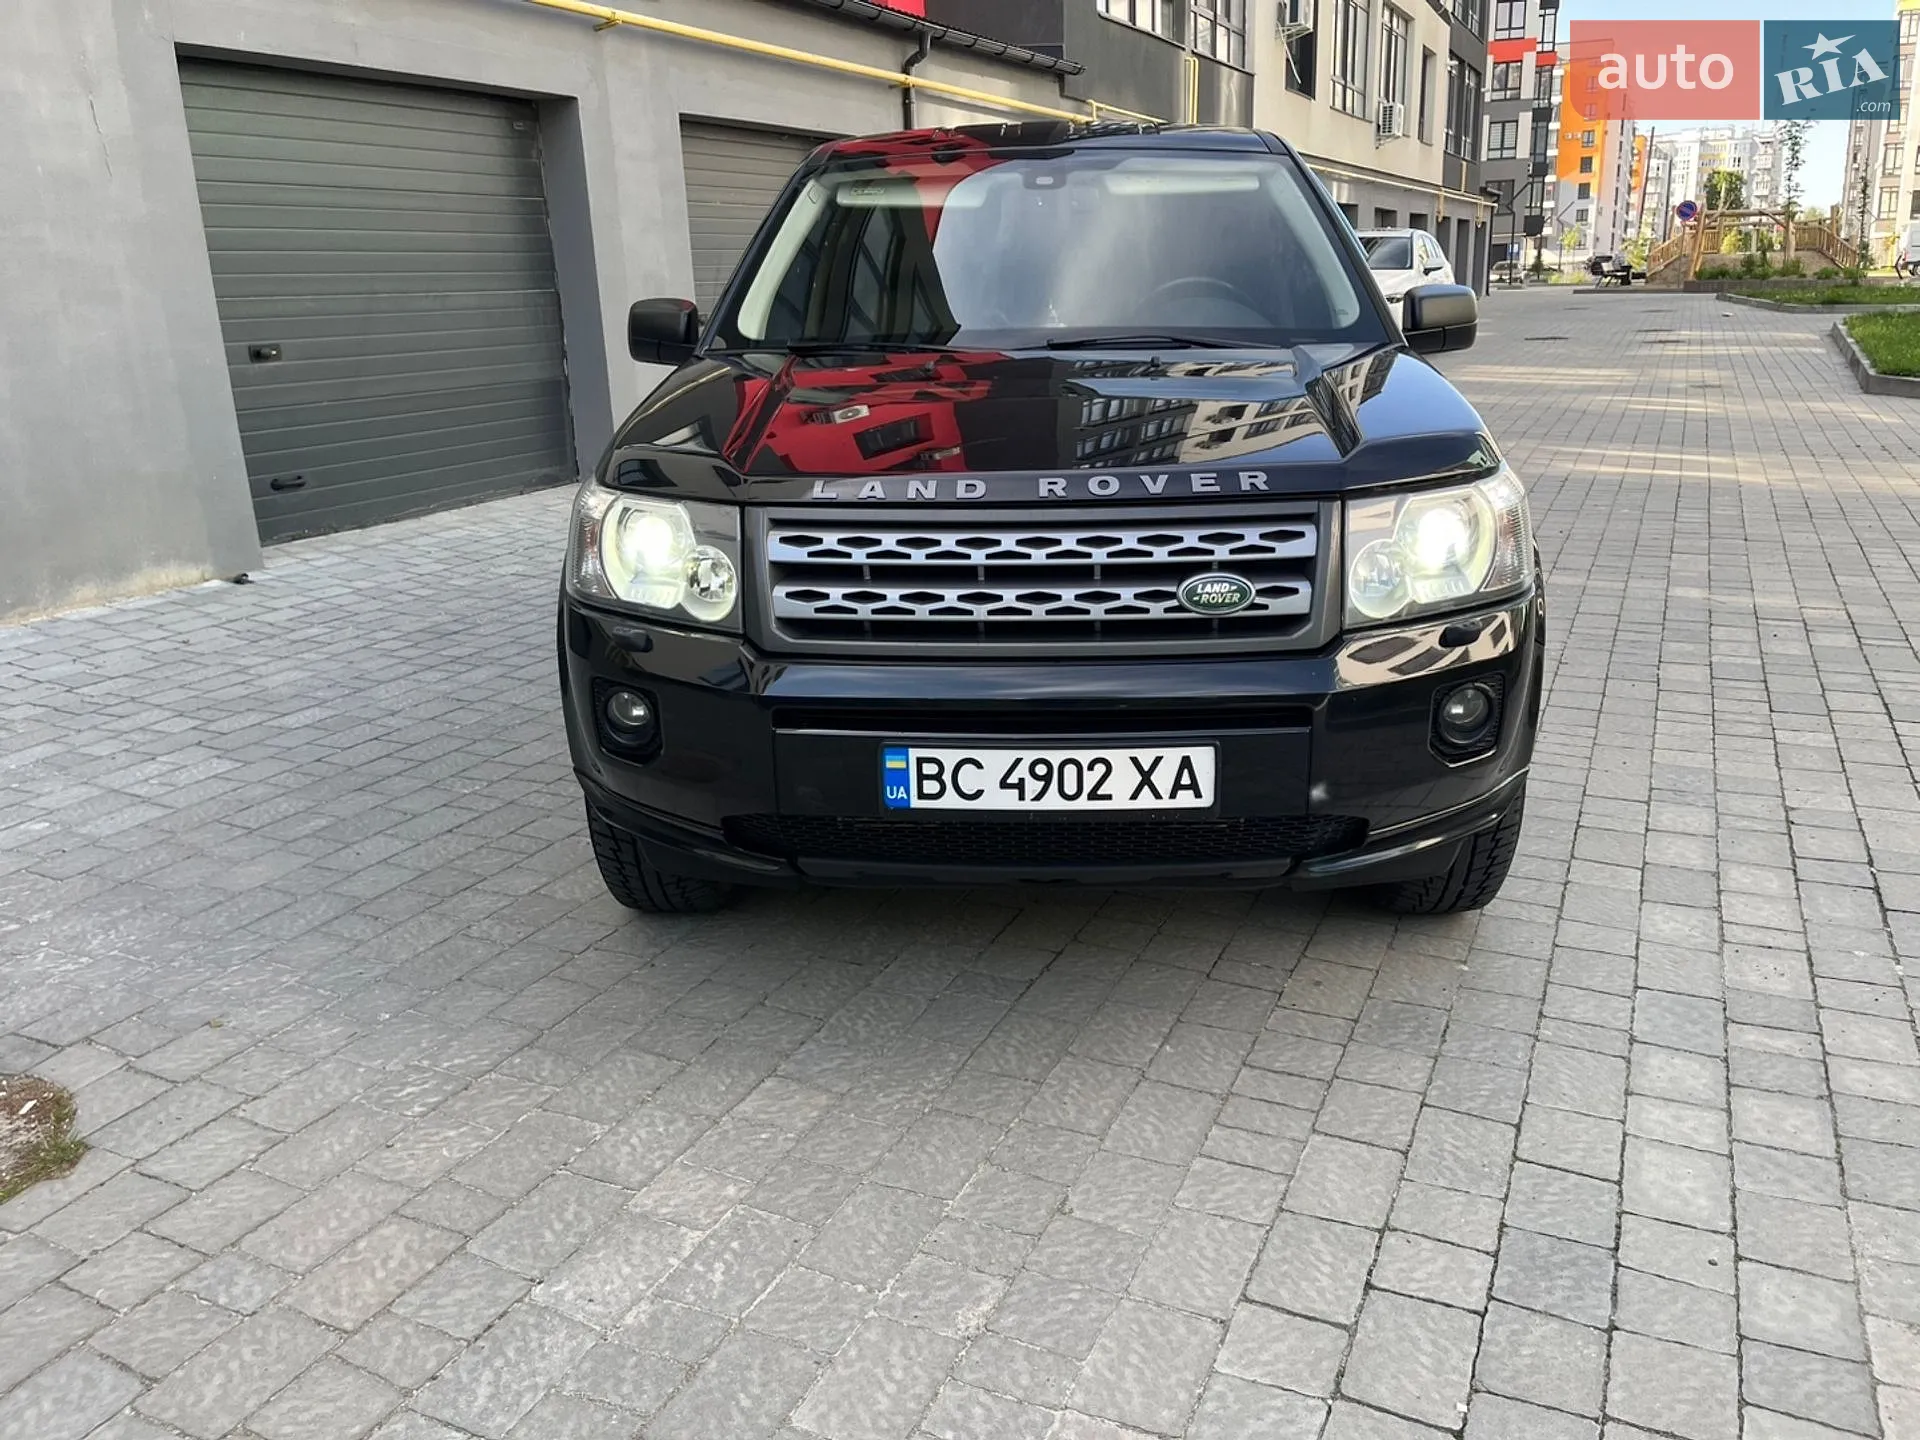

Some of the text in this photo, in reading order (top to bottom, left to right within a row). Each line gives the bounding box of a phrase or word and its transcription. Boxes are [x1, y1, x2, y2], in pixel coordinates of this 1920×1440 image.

[812, 471, 1270, 500] LAND ROVER
[886, 786, 908, 800] UA
[915, 755, 1204, 802] BC 4902 XA
